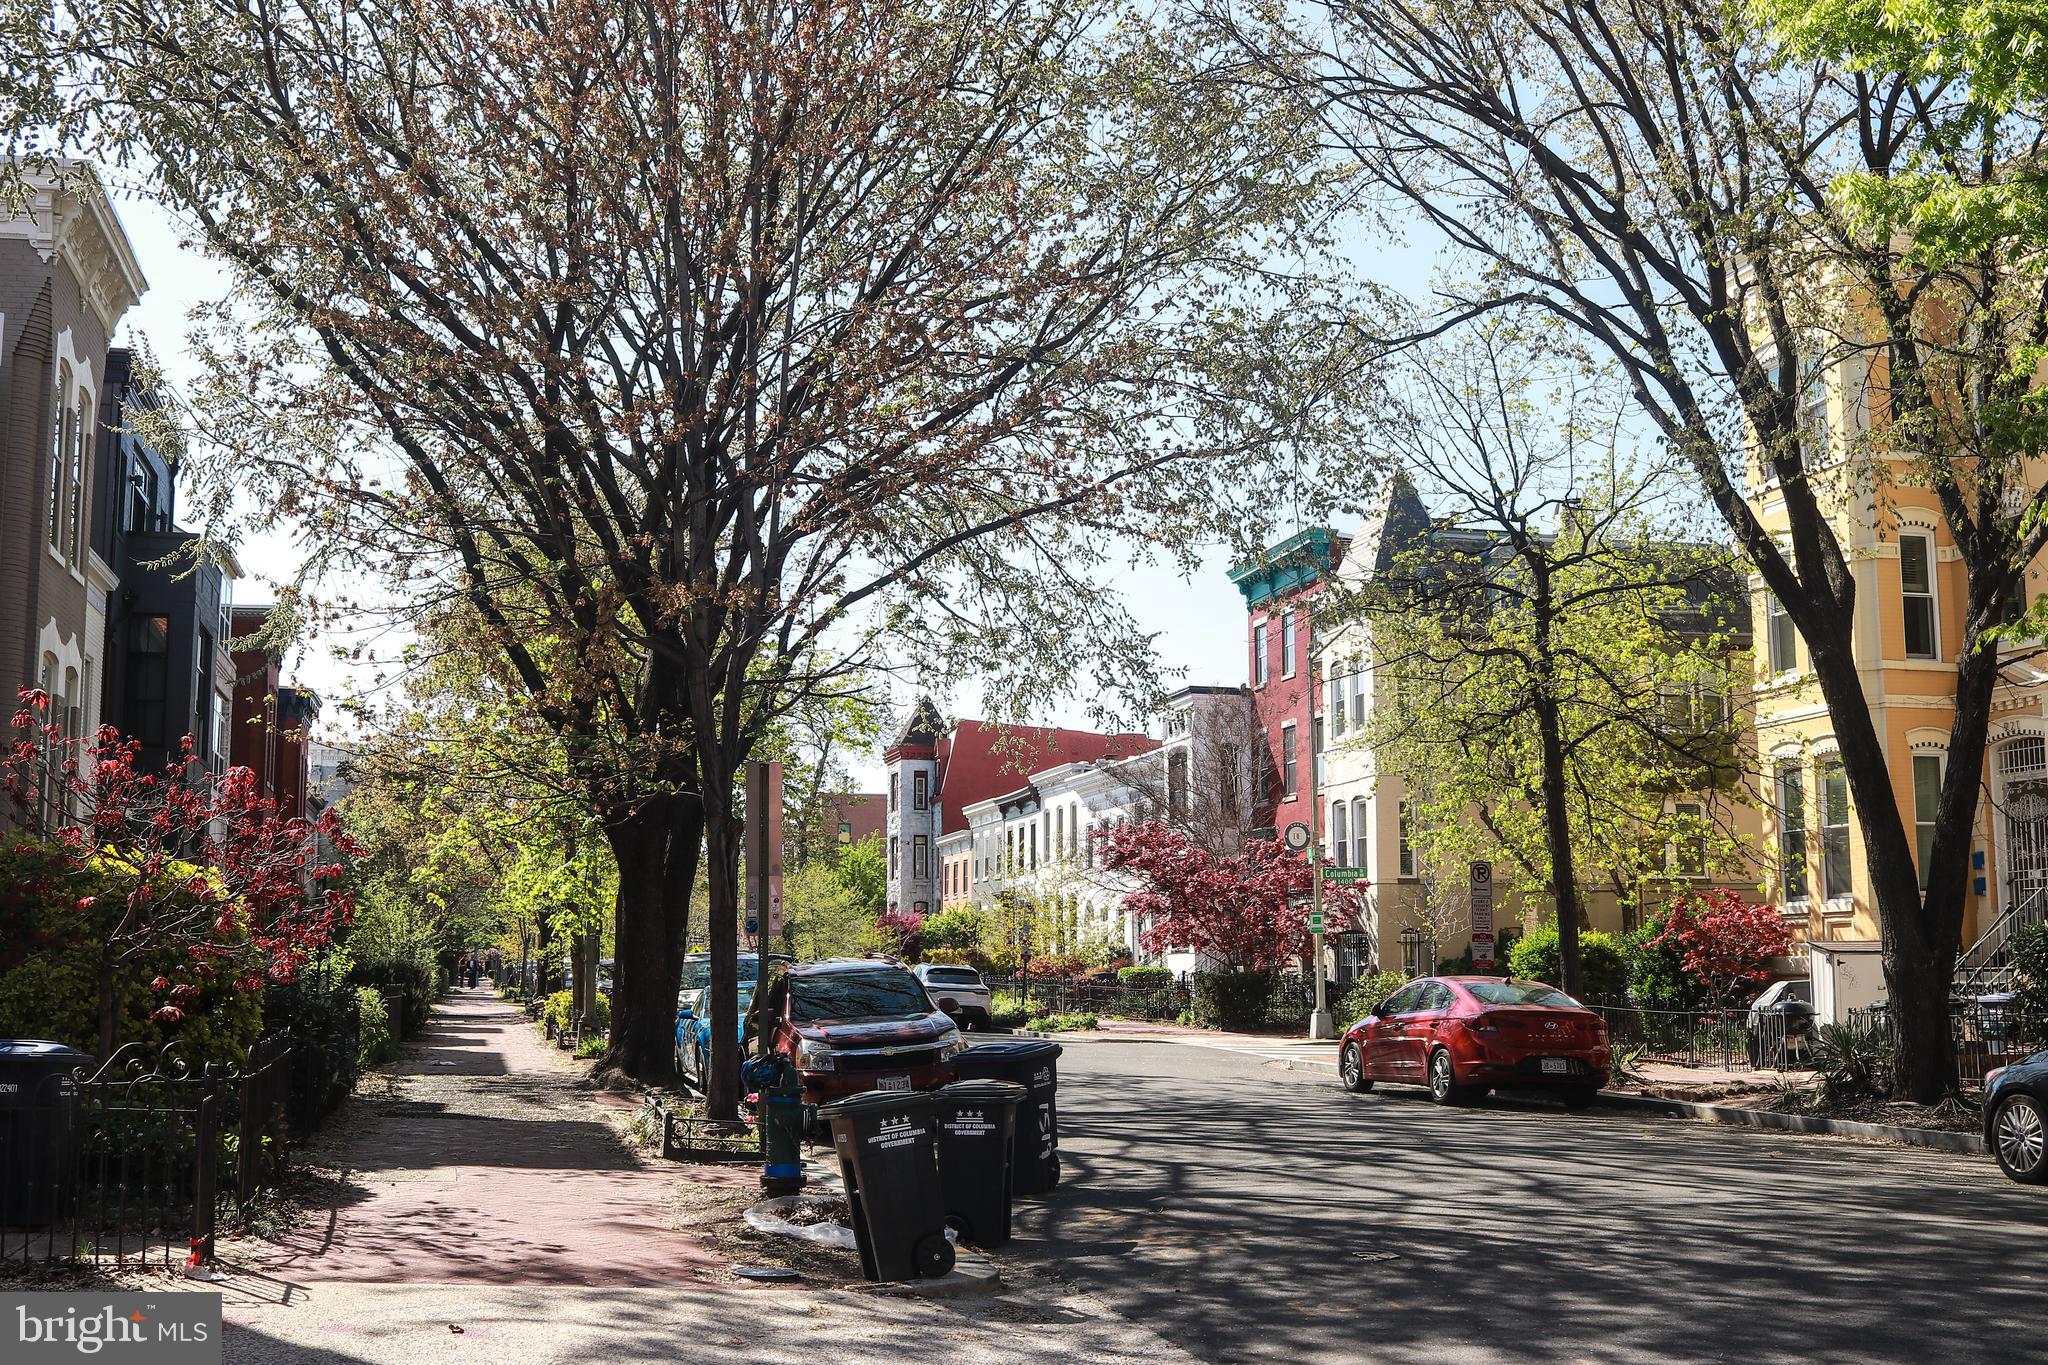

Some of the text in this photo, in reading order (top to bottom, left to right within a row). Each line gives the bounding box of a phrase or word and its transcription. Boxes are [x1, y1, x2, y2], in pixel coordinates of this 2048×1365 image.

[1325, 869, 1358, 878] Columbia
[867, 1133, 891, 1144] DISTRICT
[899, 1128, 926, 1138] COLUMBIA
[880, 1137, 915, 1149] GOVERNMENT
